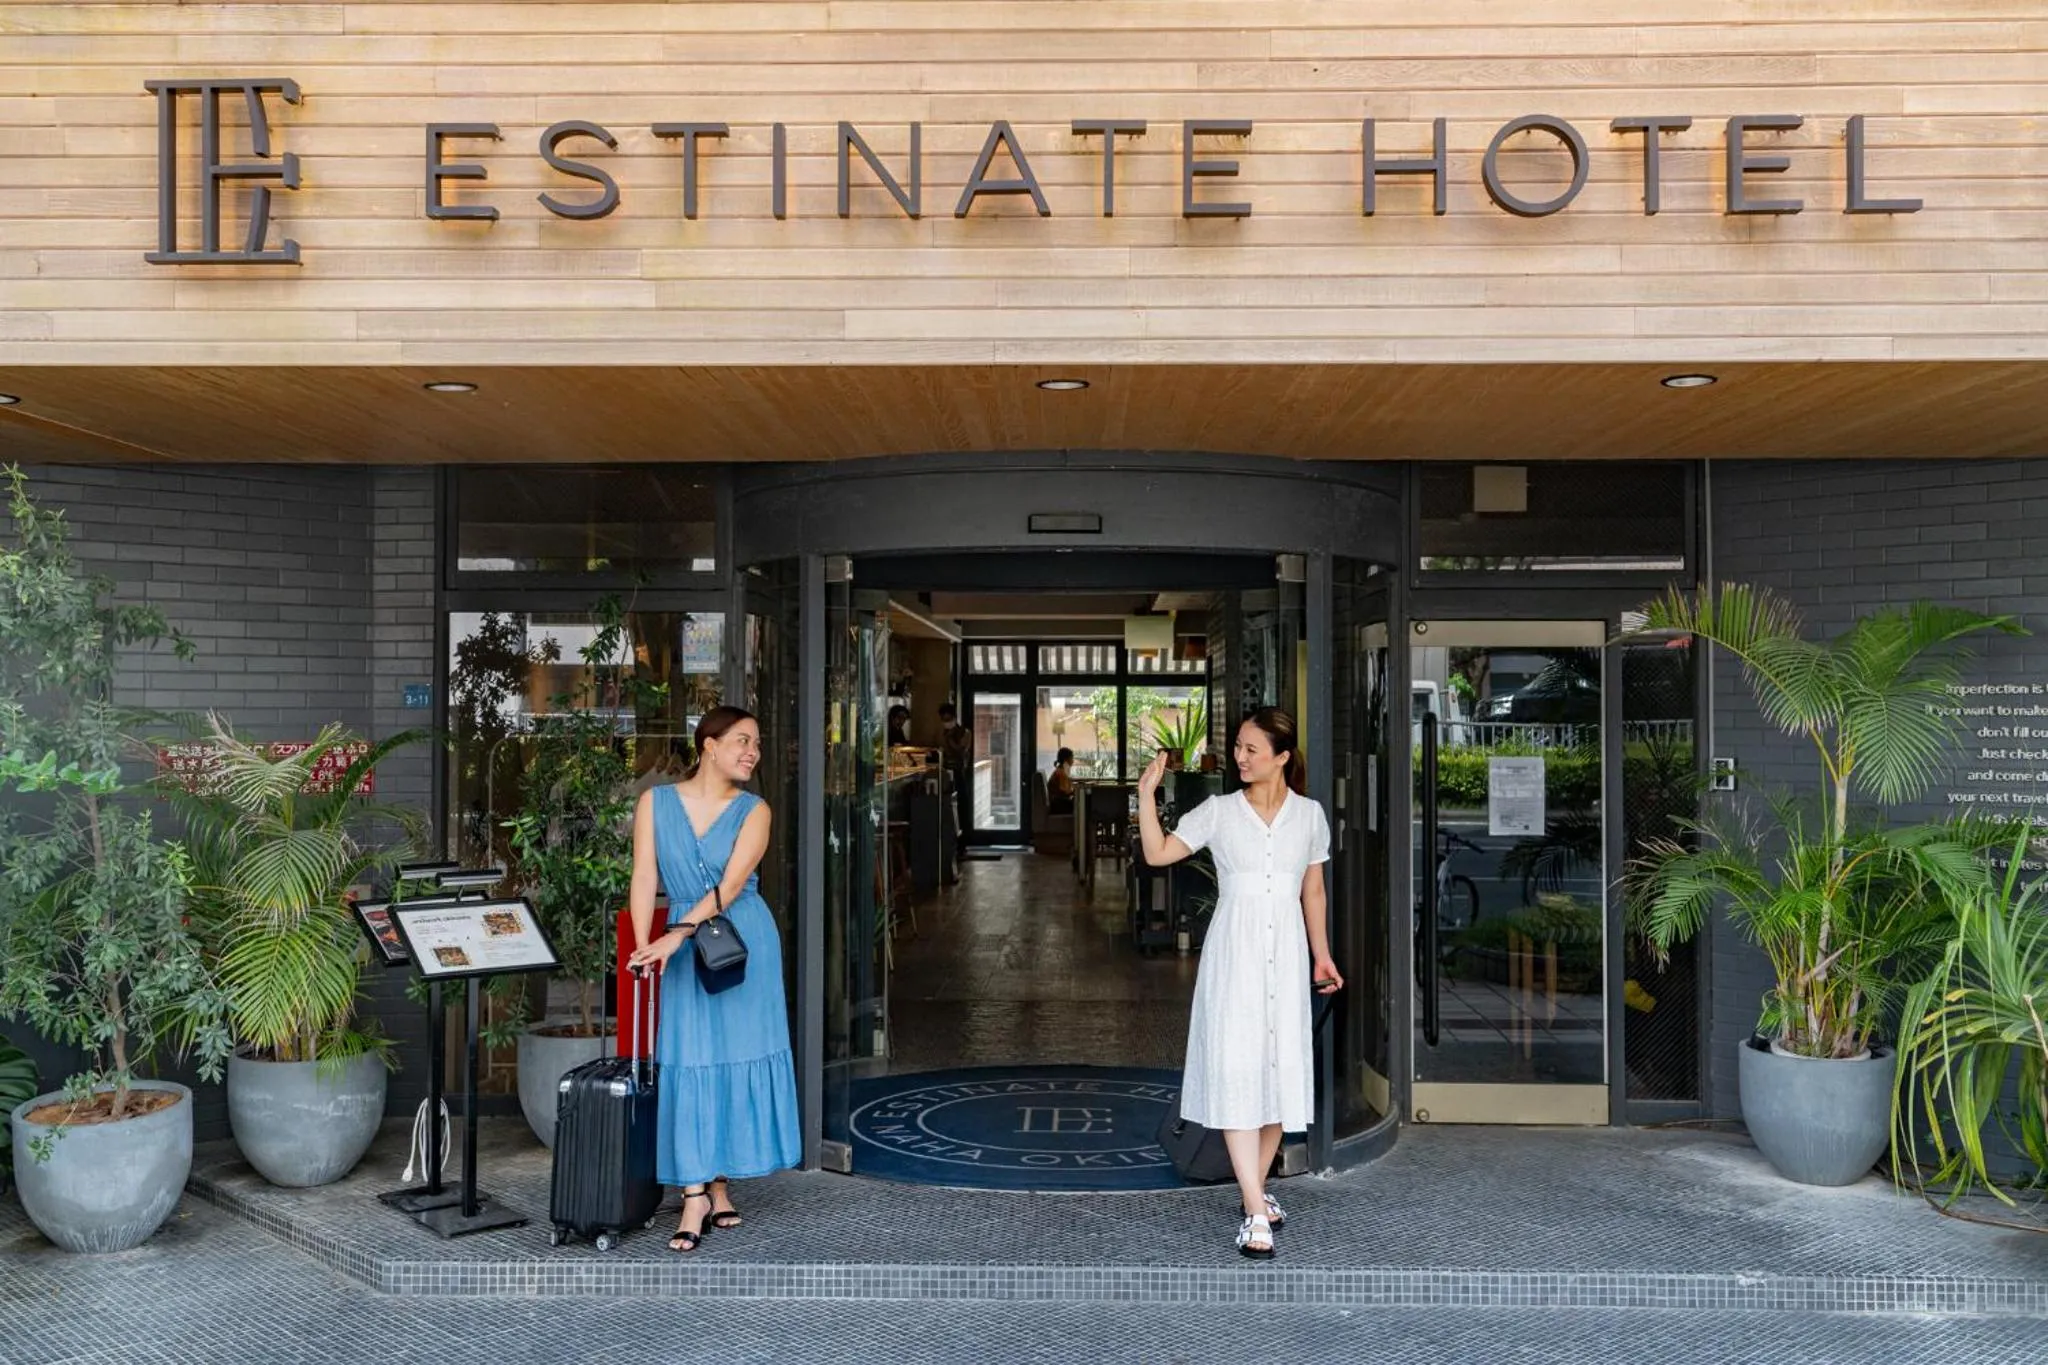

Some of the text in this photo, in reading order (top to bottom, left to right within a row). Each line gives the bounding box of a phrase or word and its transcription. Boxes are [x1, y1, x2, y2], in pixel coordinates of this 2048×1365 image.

[425, 114, 1923, 220] ESTINATE HOTEL
[2032, 683, 2044, 695] is
[1963, 705, 1996, 716] want
[1997, 706, 2012, 716] to
[1977, 726, 2010, 738] don't
[2013, 726, 2030, 738] fill
[1977, 748, 2006, 760] Just
[1967, 769, 1994, 781] and
[1995, 772, 2033, 782] come
[1947, 793, 1978, 803] your
[1980, 793, 2009, 802] next
[871, 1081, 1103, 1119] ESTINATE
[870, 1124, 983, 1161] NAHA
[1019, 1145, 1168, 1166] OKIN
